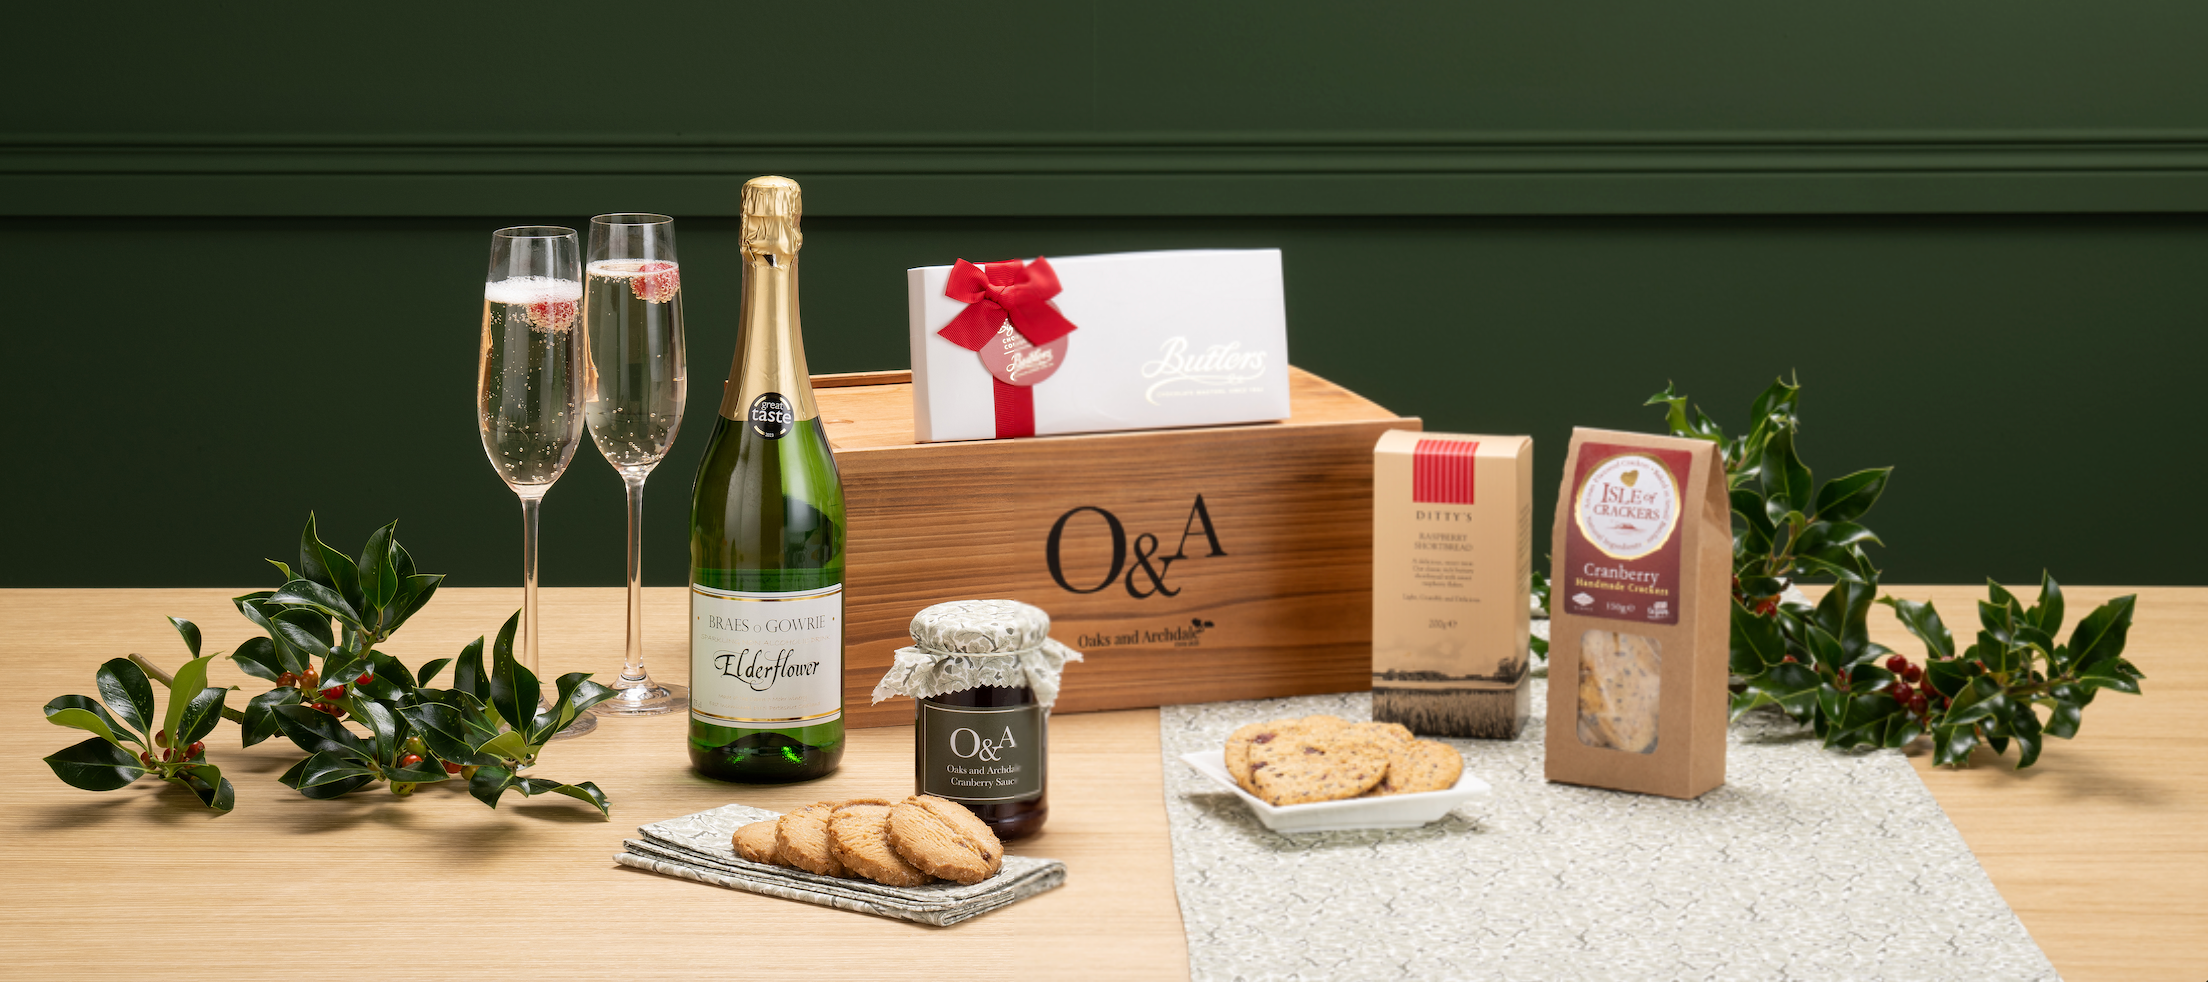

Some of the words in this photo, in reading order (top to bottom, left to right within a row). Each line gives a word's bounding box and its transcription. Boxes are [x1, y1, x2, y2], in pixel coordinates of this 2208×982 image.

[1141, 336, 1267, 386] Butlers
[761, 401, 784, 411] great
[752, 408, 792, 425] taste
[1600, 482, 1642, 506] ISLE
[1643, 492, 1659, 505] of
[1416, 510, 1472, 523] DITTY'S
[1592, 504, 1660, 520] CRACKERS
[1419, 532, 1468, 542] RASPBERRY
[1046, 493, 1229, 600] O&A
[1414, 541, 1474, 552] SHORTBREAD
[1584, 562, 1660, 589] Cranberry
[1575, 577, 1625, 590] Handmade
[1627, 583, 1669, 597] Crackers
[709, 614, 750, 633] BRAES
[766, 614, 826, 633] GOWRIE
[700, 633, 740, 645] SPARKLING
[764, 638, 809, 646] ALCOHOLIC
[810, 635, 831, 643] DRINK
[1078, 632, 1111, 648] Oaks
[1113, 630, 1139, 645] and
[1142, 625, 1200, 644] Archdale
[713, 648, 820, 692] Elderflower
[950, 725, 1017, 762] O&A
[946, 764, 968, 774] Oaks
[969, 766, 985, 775] and
[950, 777, 994, 789] Cranberry
